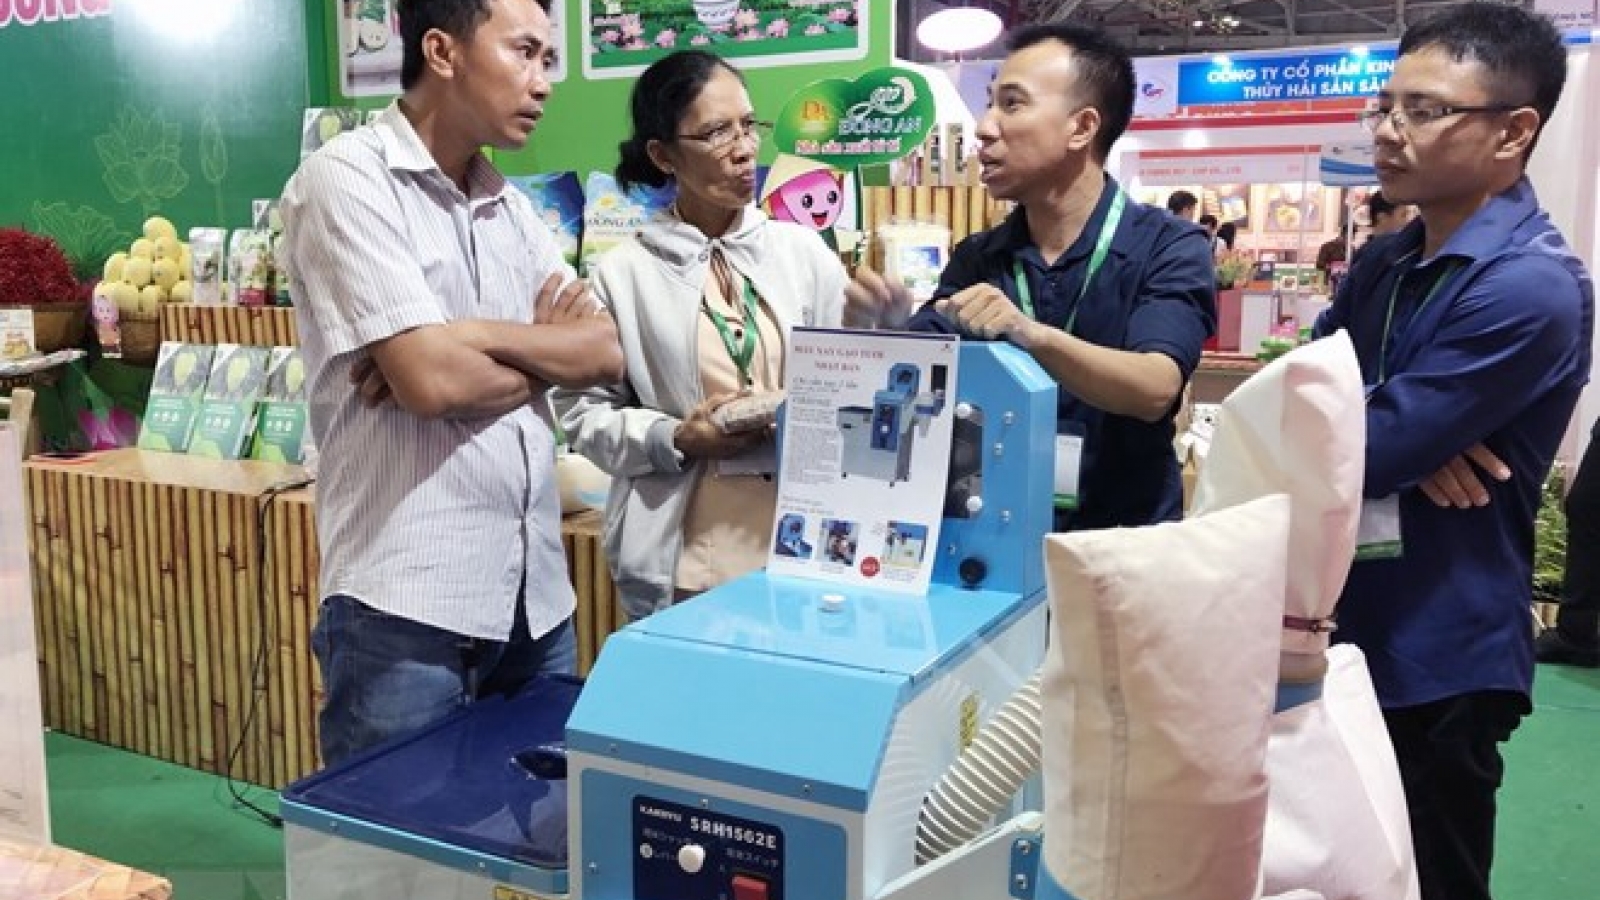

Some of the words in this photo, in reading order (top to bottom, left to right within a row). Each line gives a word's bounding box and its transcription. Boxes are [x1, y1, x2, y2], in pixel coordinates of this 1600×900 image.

[1261, 66, 1280, 81] TY
[1282, 58, 1310, 79] CỔ
[1367, 60, 1395, 74] KIN
